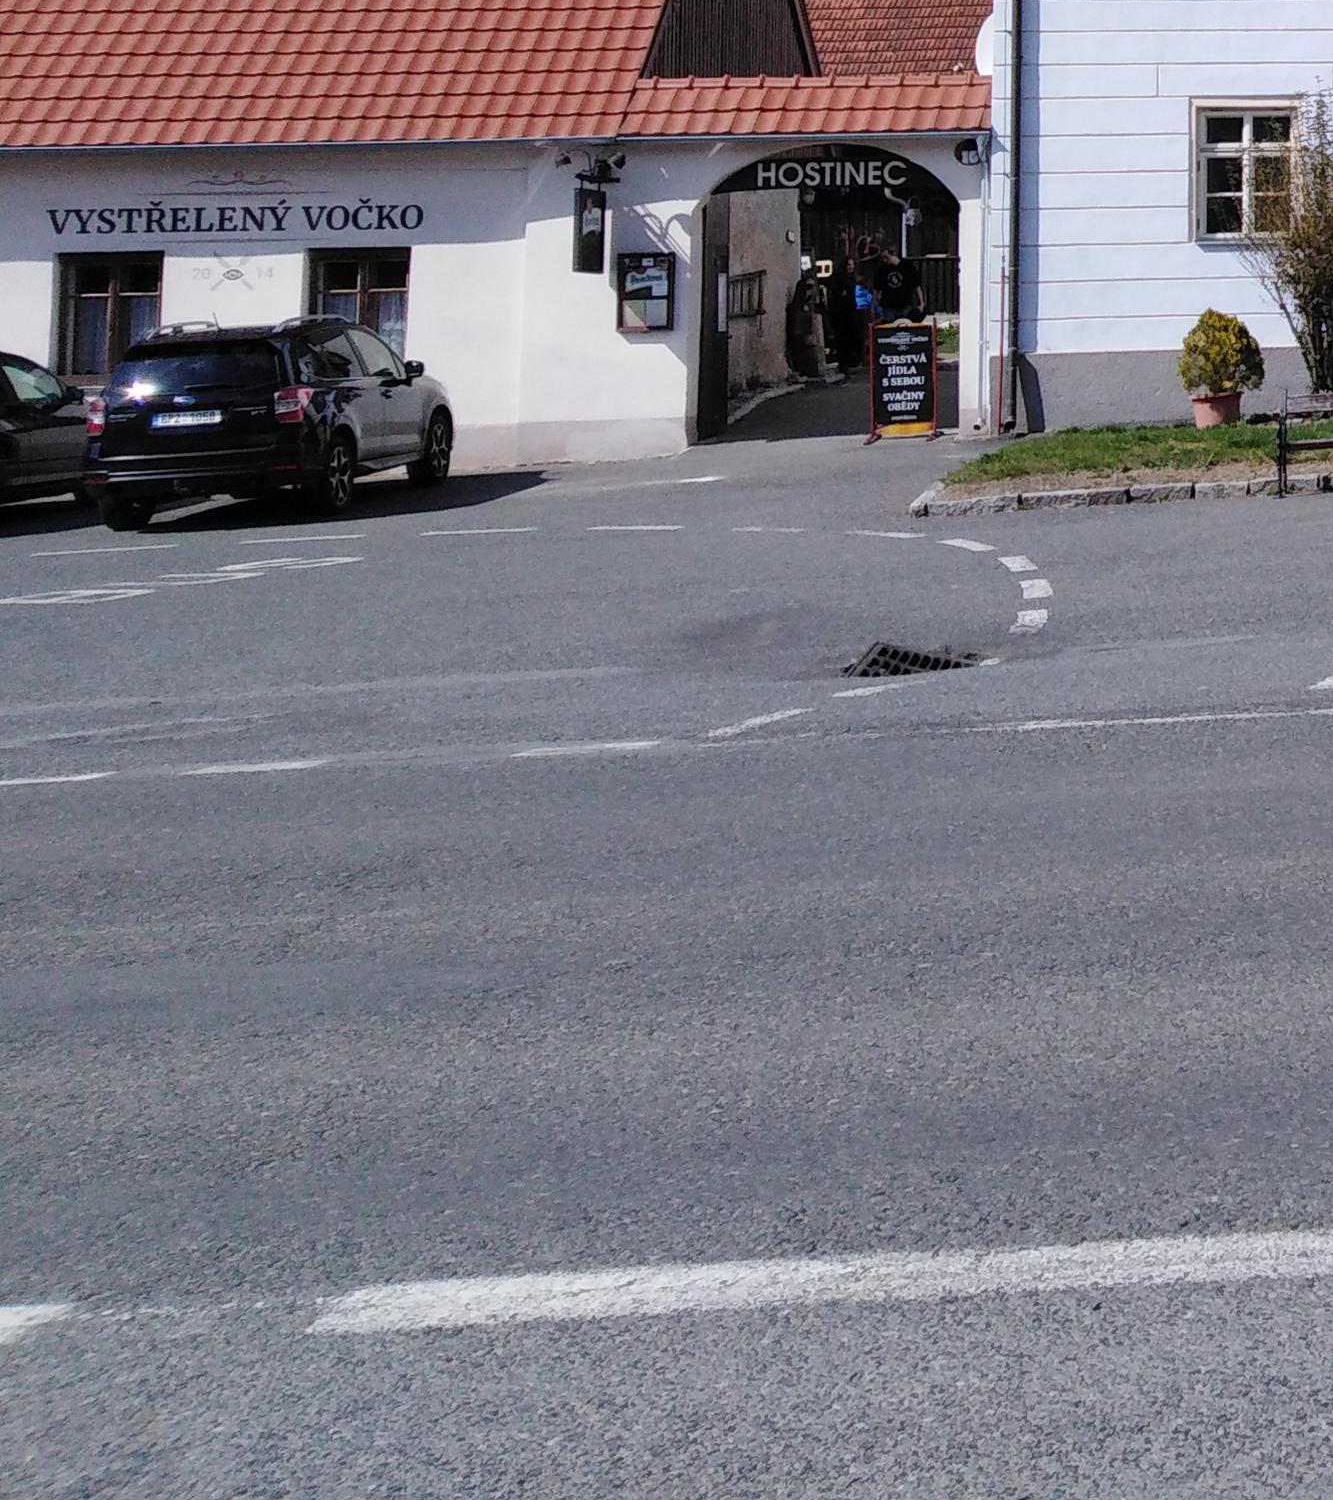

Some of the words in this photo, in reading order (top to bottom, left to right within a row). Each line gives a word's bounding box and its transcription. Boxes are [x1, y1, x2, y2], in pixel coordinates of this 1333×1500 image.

[757, 160, 908, 188] HOSTINEC
[46, 199, 292, 235] VYSTŘELENÝ
[301, 198, 425, 231] VOČKO
[879, 352, 927, 365] ČERSTVÁ
[887, 365, 917, 377] JÍDLA
[882, 378, 889, 387] S
[890, 376, 925, 387] SEBOU
[882, 390, 925, 402] SVAČINY
[887, 401, 920, 411] OBĚDY
